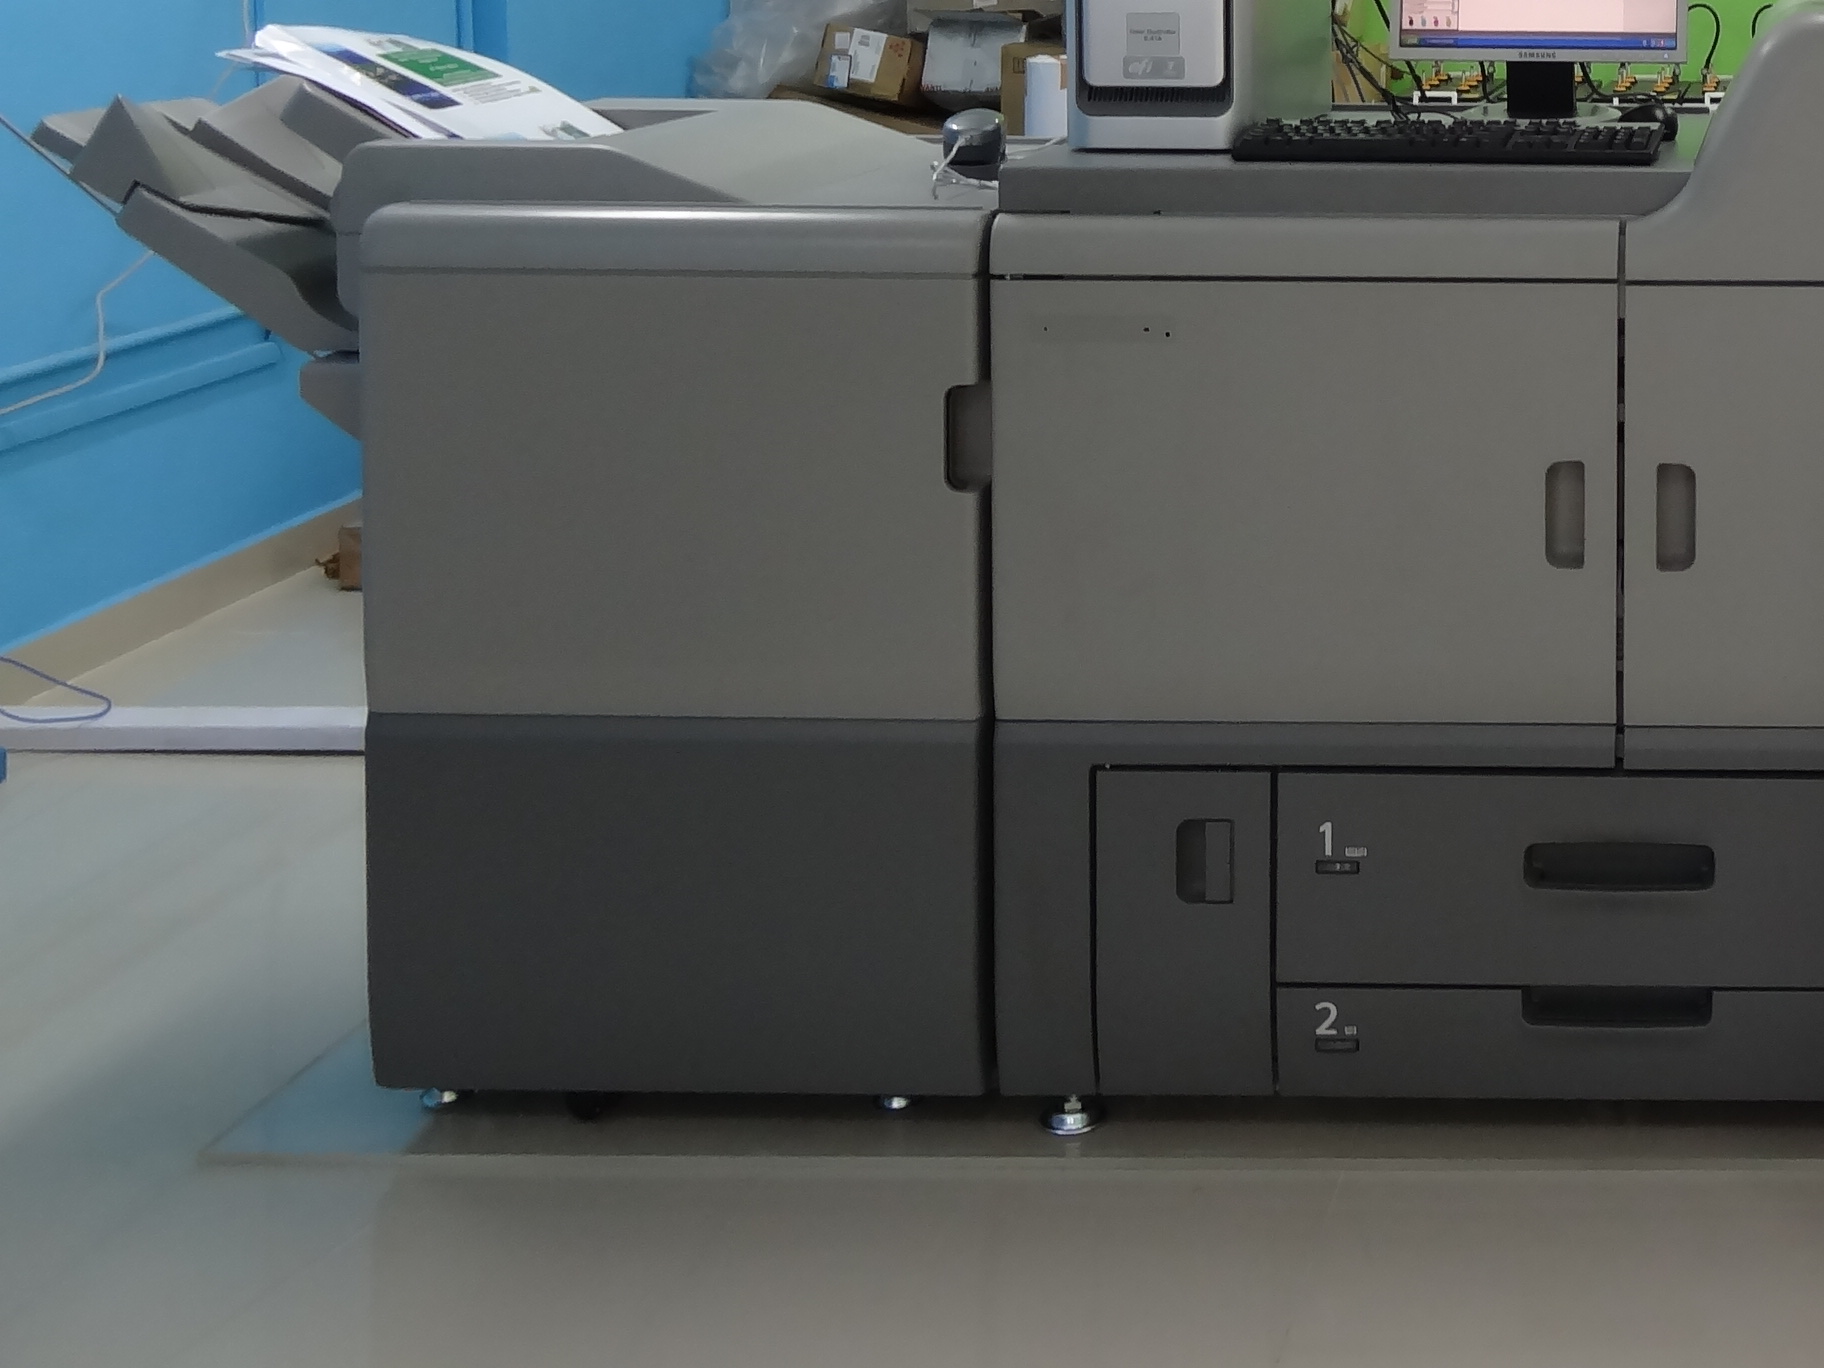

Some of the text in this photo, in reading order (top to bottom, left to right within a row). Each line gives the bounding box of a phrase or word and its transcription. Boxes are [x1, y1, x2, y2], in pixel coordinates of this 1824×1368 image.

[1518, 50, 1557, 59] SAMSUNG
[1319, 821, 1333, 857] 1
[1315, 1001, 1338, 1035] 2
